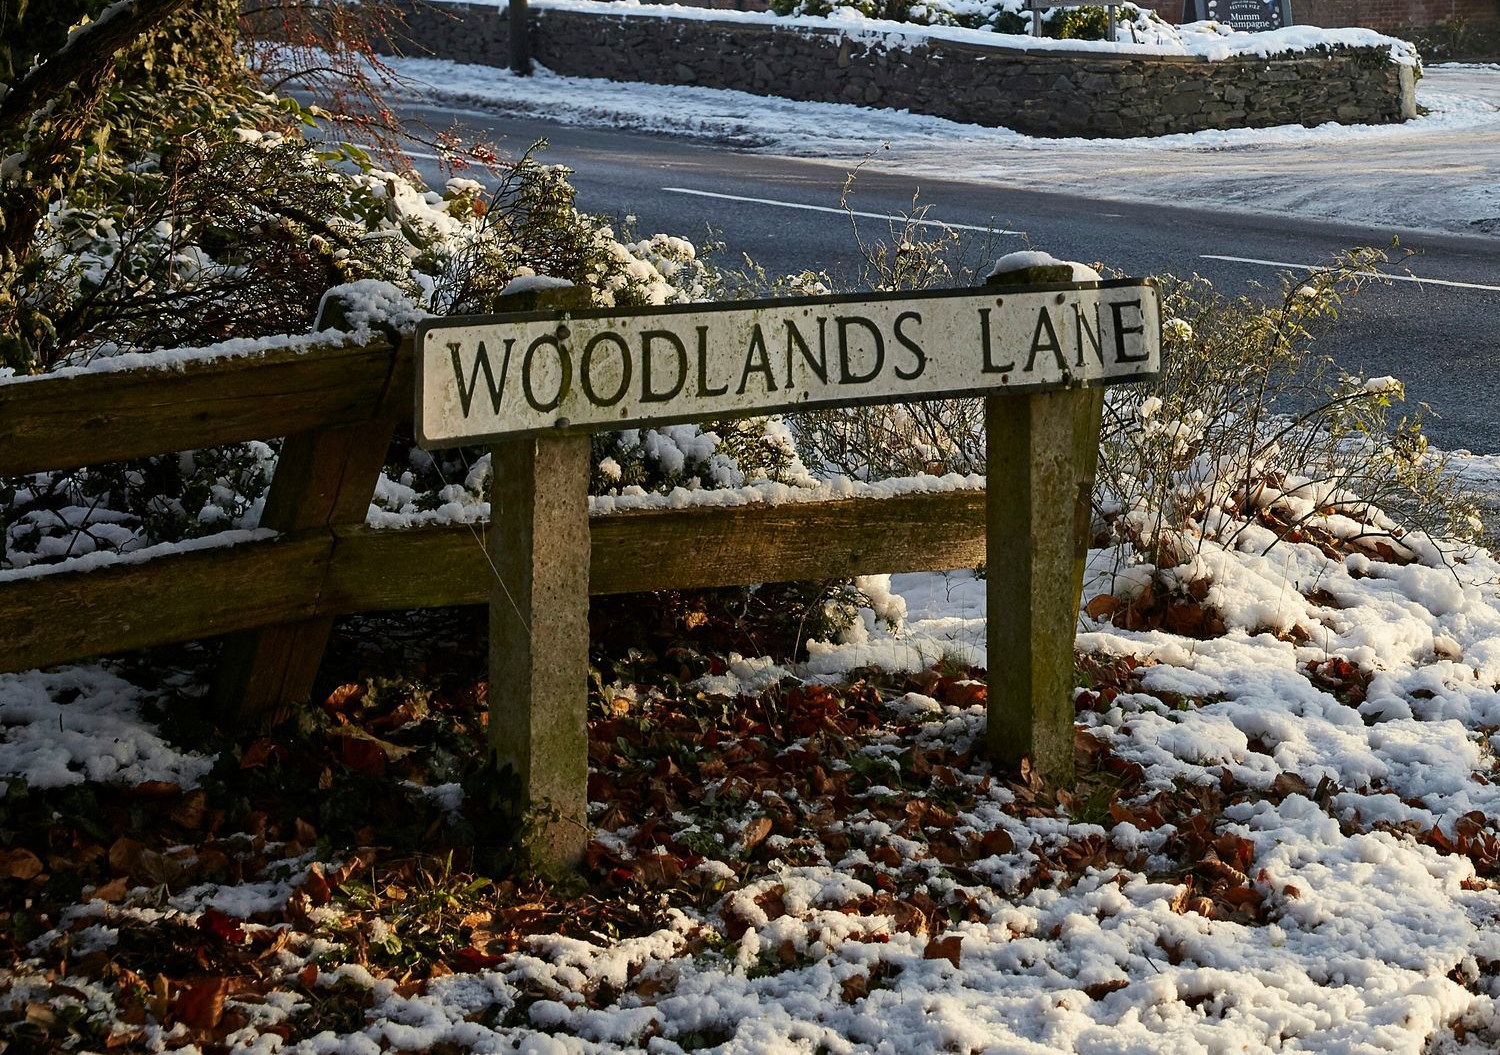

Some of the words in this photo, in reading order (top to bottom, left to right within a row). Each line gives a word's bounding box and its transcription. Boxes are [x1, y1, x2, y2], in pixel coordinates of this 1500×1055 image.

[1222, 21, 1270, 29] Champagne
[446, 310, 927, 419] WOODLANDS
[978, 298, 1150, 373] LANE
